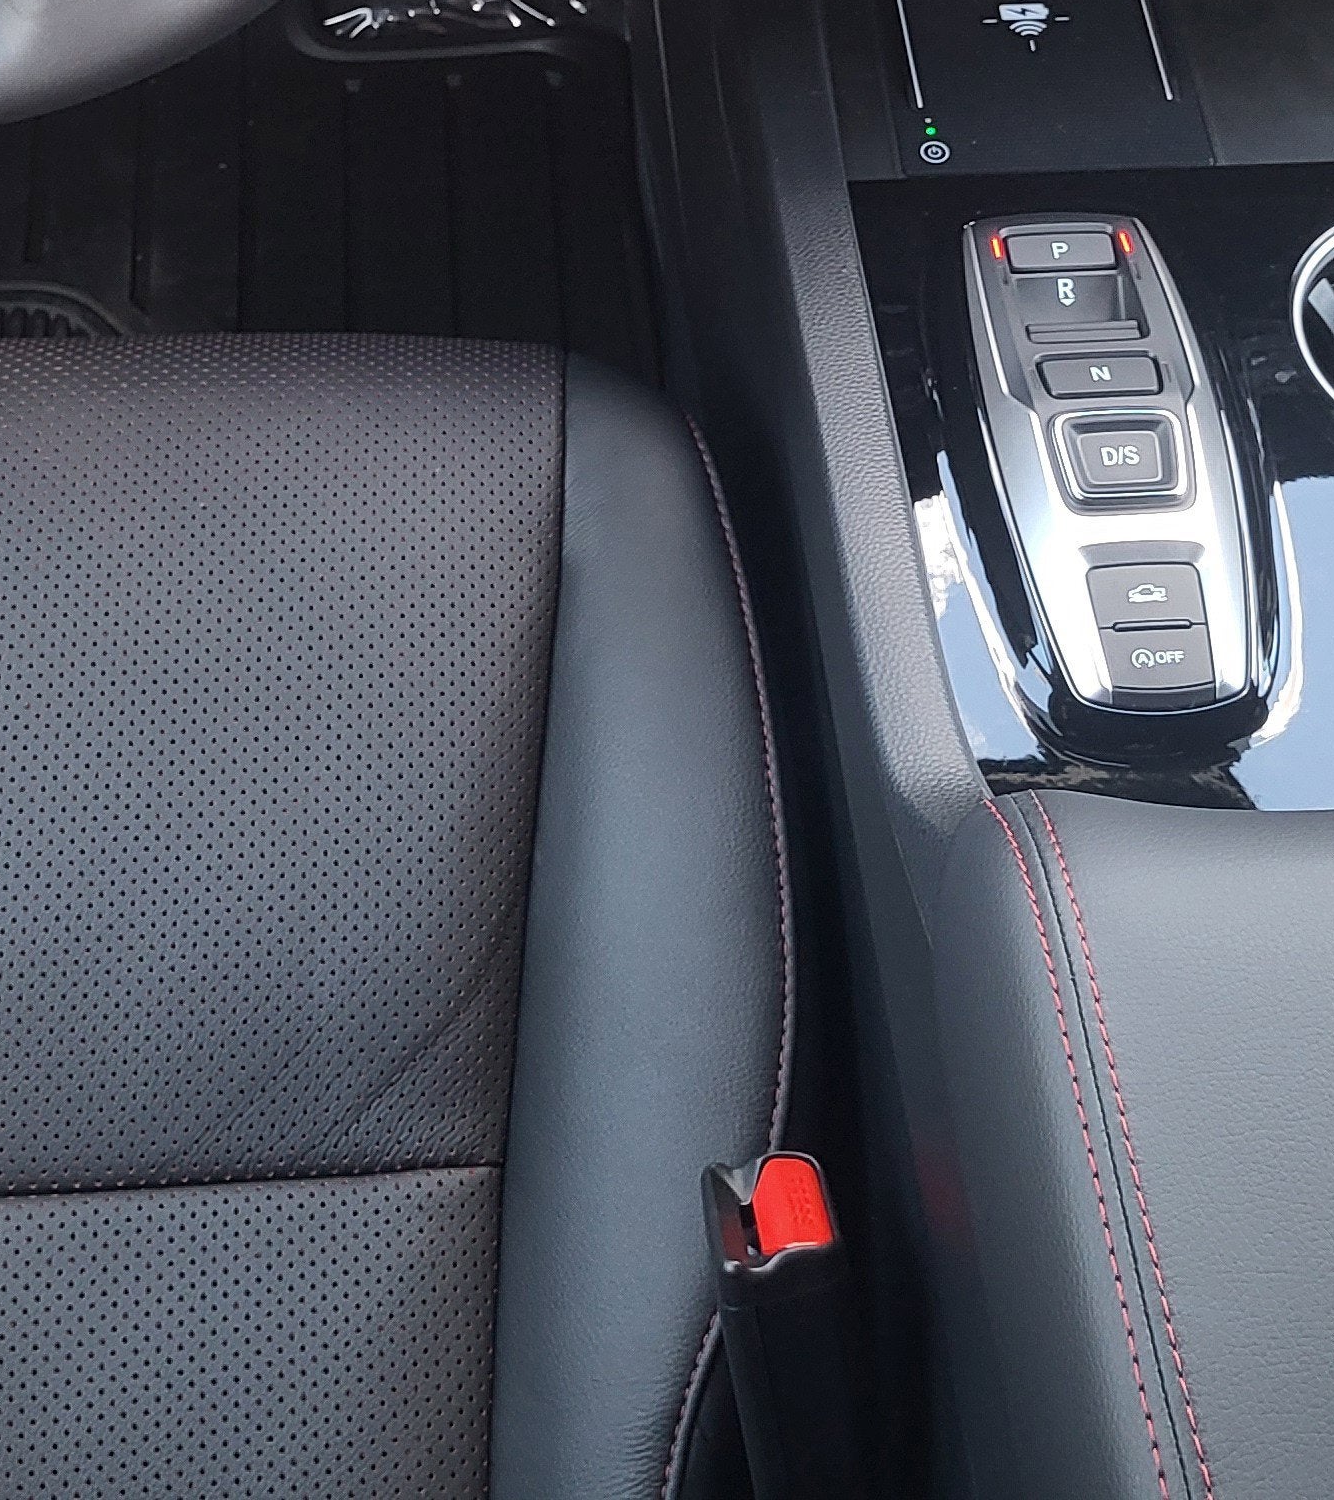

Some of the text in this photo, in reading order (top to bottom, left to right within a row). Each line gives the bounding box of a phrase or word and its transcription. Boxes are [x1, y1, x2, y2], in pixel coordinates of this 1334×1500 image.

[1051, 242, 1069, 259] P
[1057, 277, 1077, 300] R
[1089, 365, 1111, 382] N
[1100, 445, 1140, 466] D/S
[1155, 650, 1185, 665] OFF
